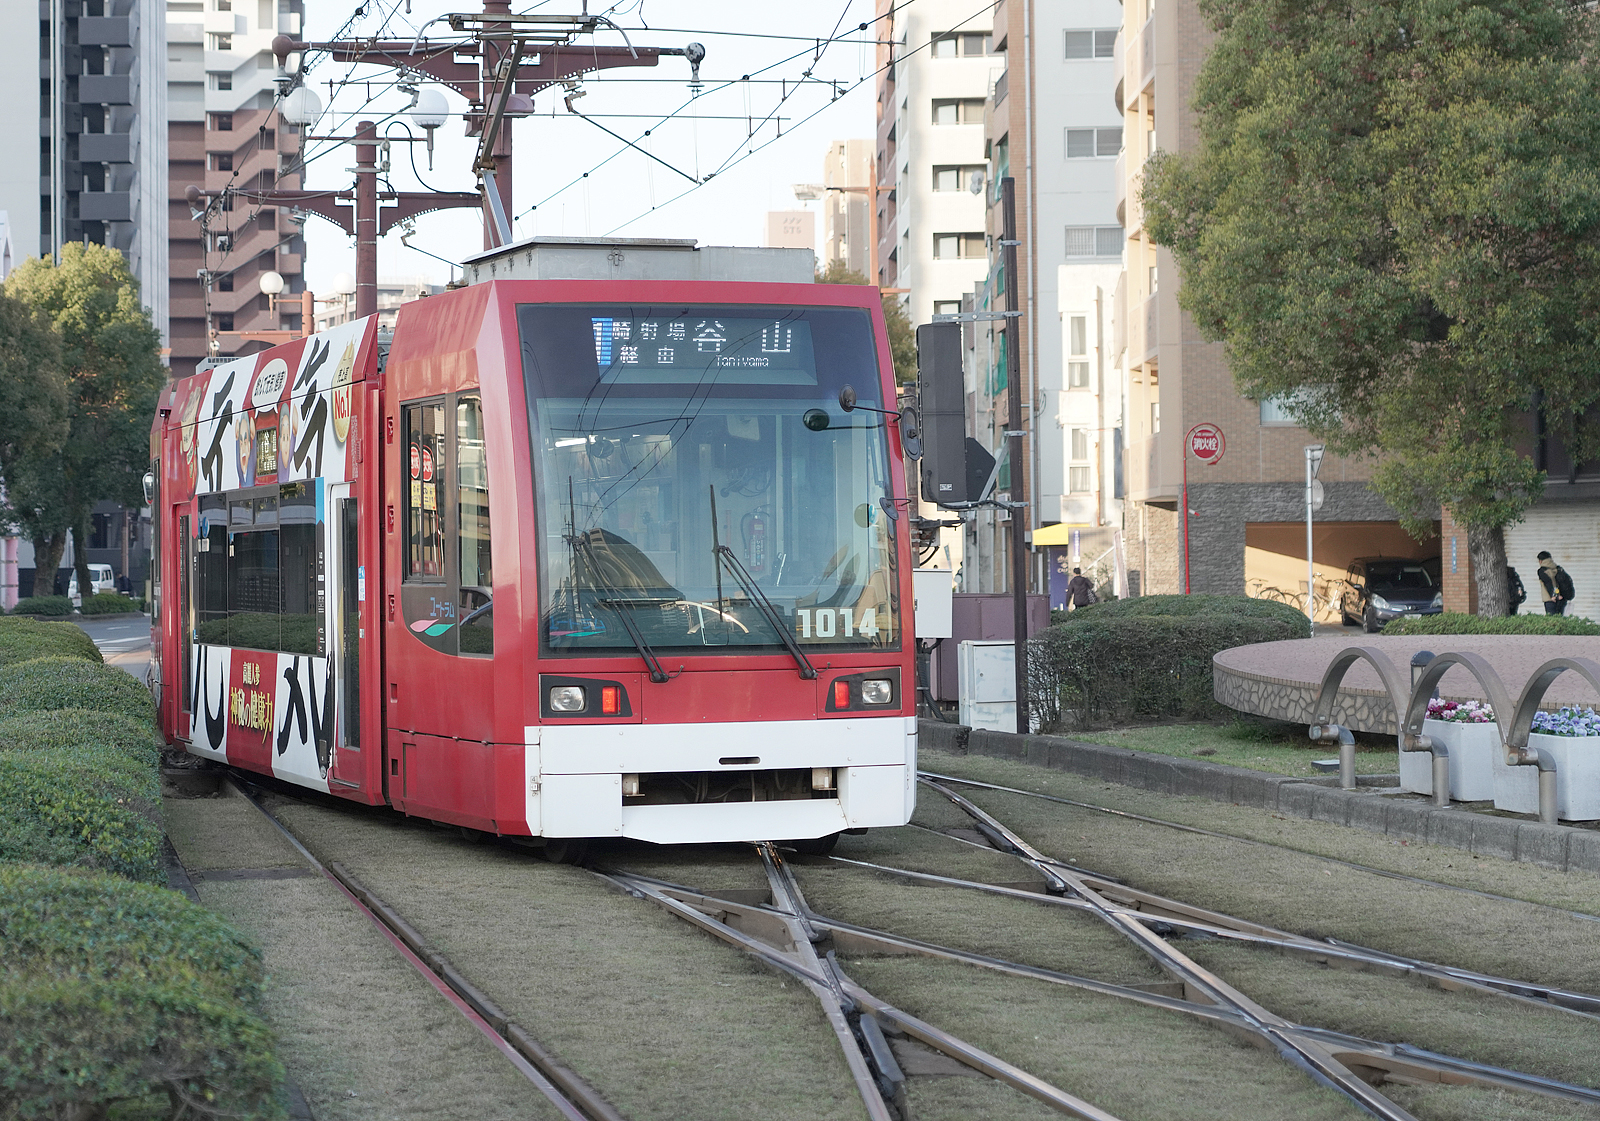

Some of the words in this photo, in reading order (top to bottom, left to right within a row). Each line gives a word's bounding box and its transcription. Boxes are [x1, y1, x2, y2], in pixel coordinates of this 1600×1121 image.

[692, 320, 792, 353] 谷山
[334, 386, 350, 420] No.1
[1193, 437, 1218, 451] 消火栓
[429, 596, 455, 618] ユートラム
[549, 615, 607, 630] ユートラム
[797, 607, 880, 638] 1014
[229, 684, 272, 742] 神秘の健康力
